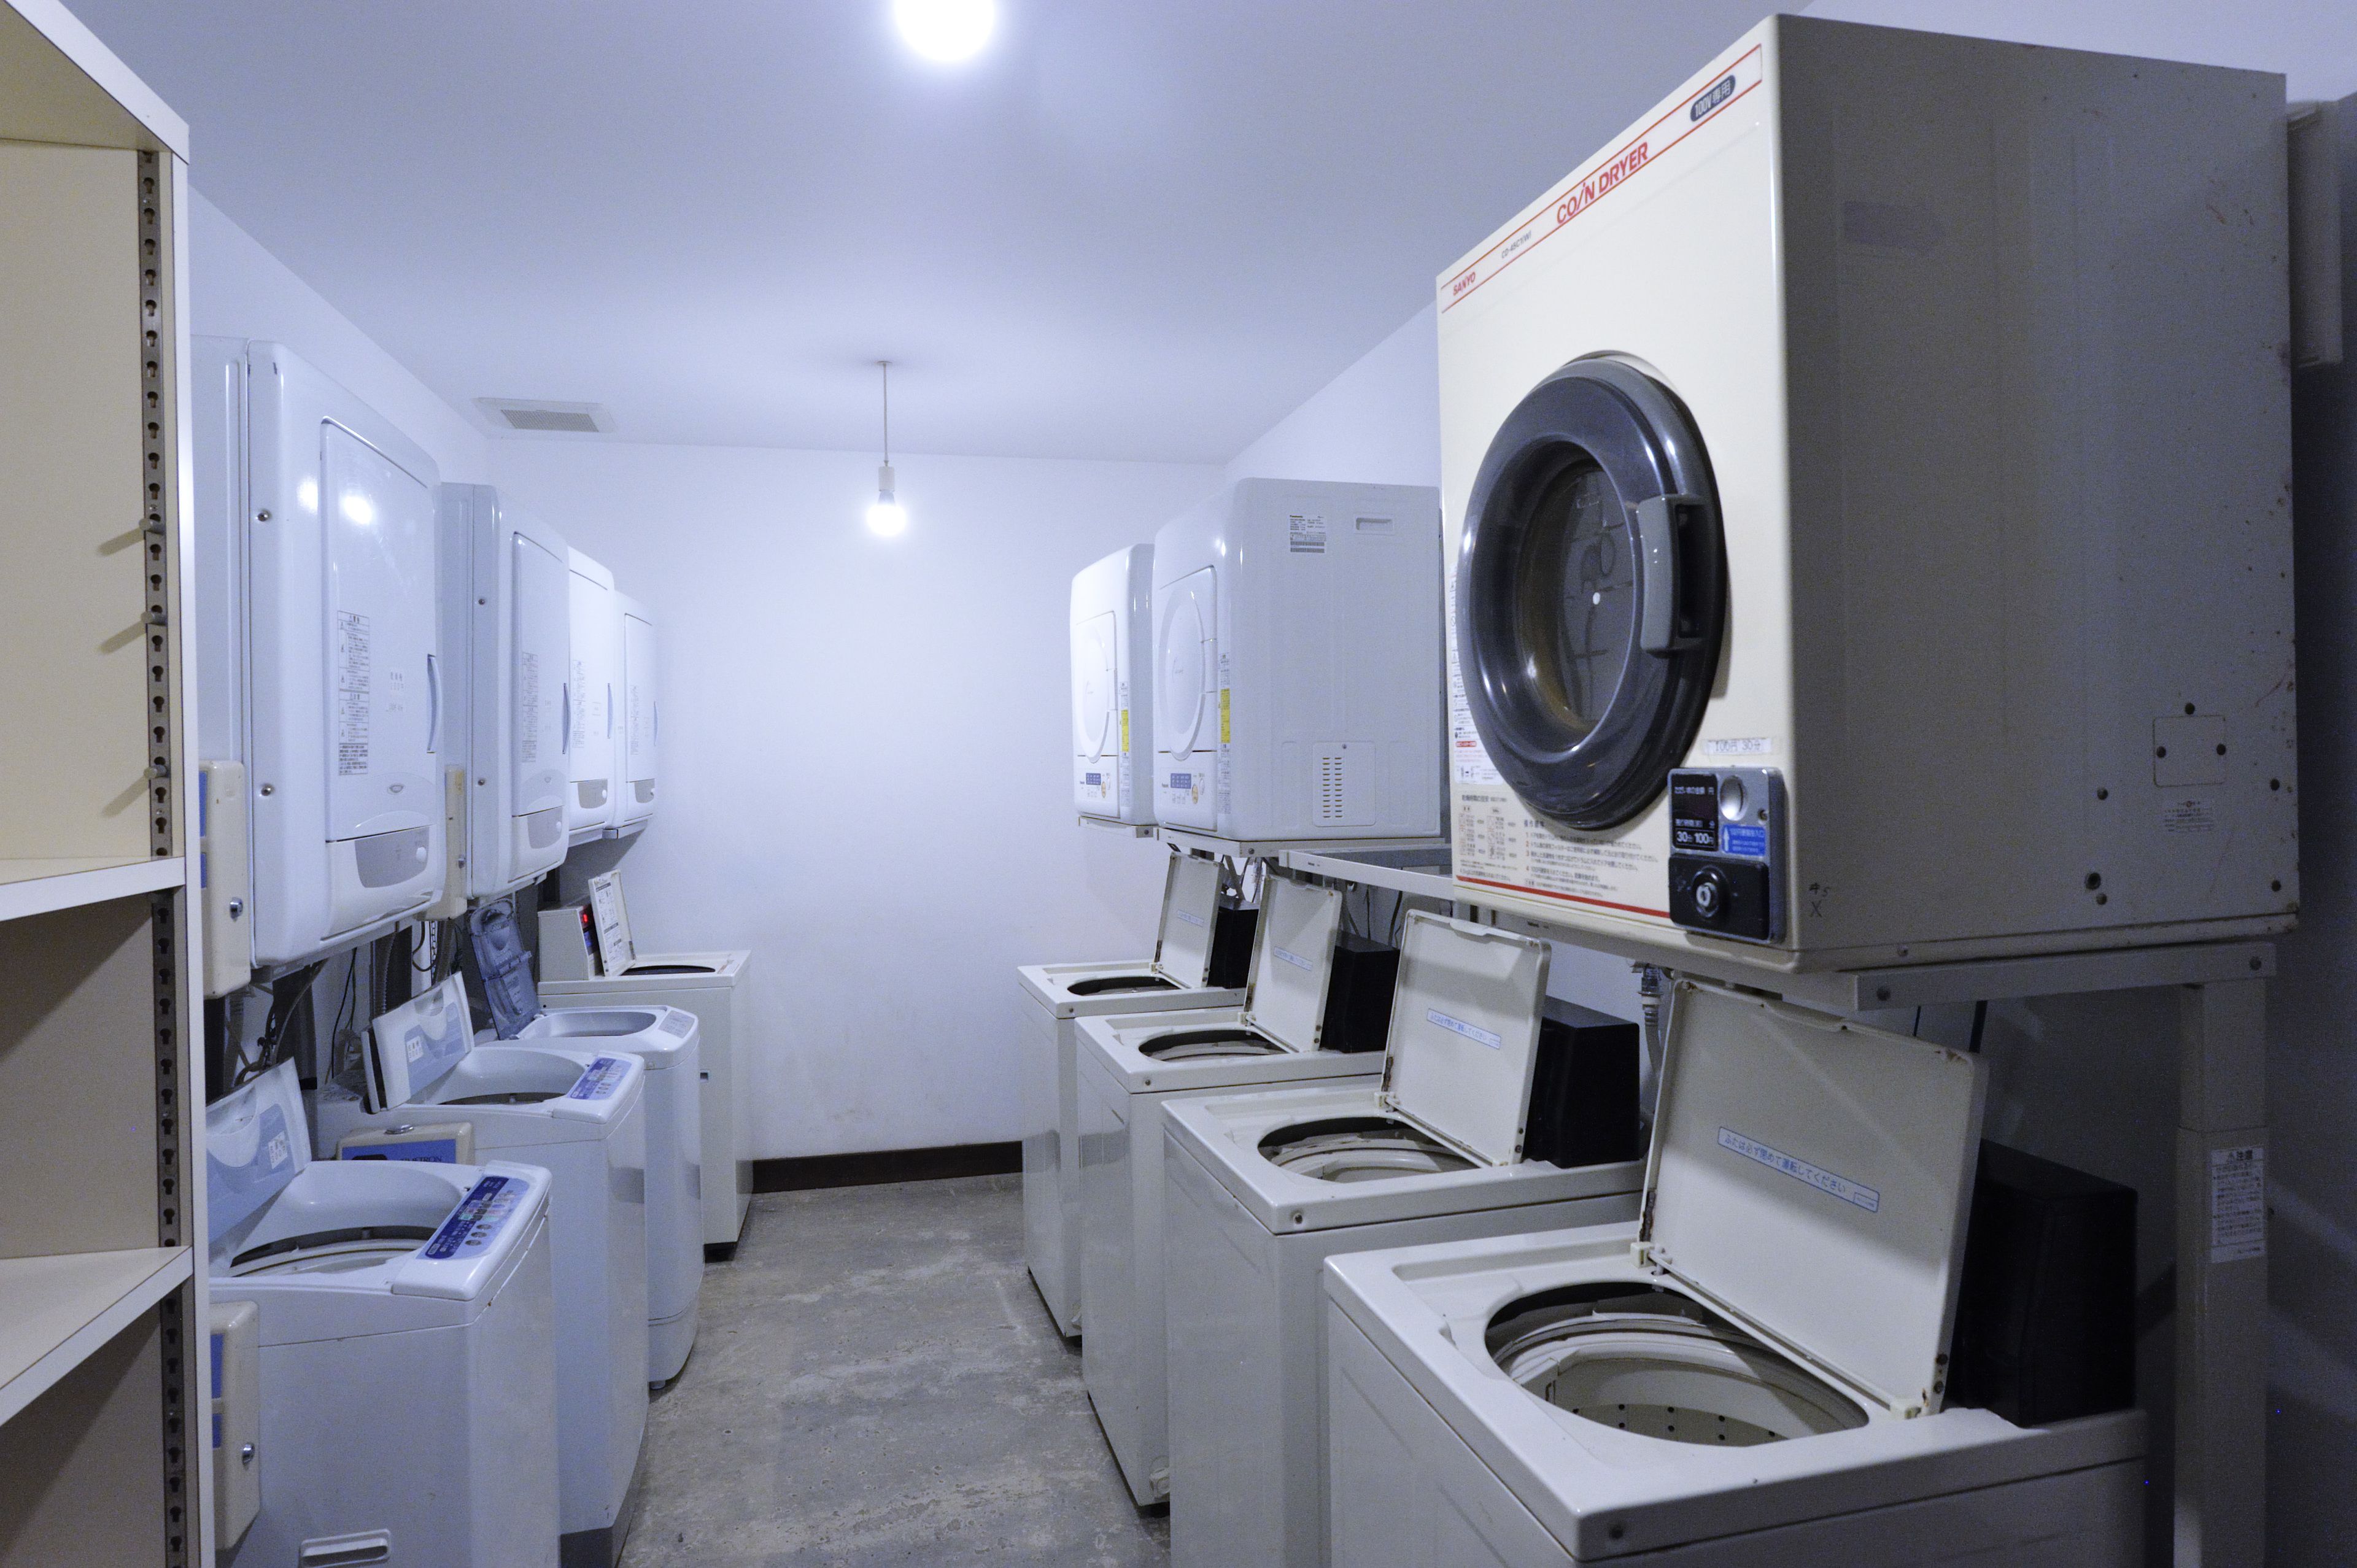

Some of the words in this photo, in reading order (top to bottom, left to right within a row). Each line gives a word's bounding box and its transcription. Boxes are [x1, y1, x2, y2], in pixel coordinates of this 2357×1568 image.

[1557, 182, 1595, 224] COIN
[1599, 142, 1648, 193] DRYER
[1453, 271, 1476, 296] SANYO
[1724, 1134, 1846, 1194] ふたは必ず閉めて運転してください
